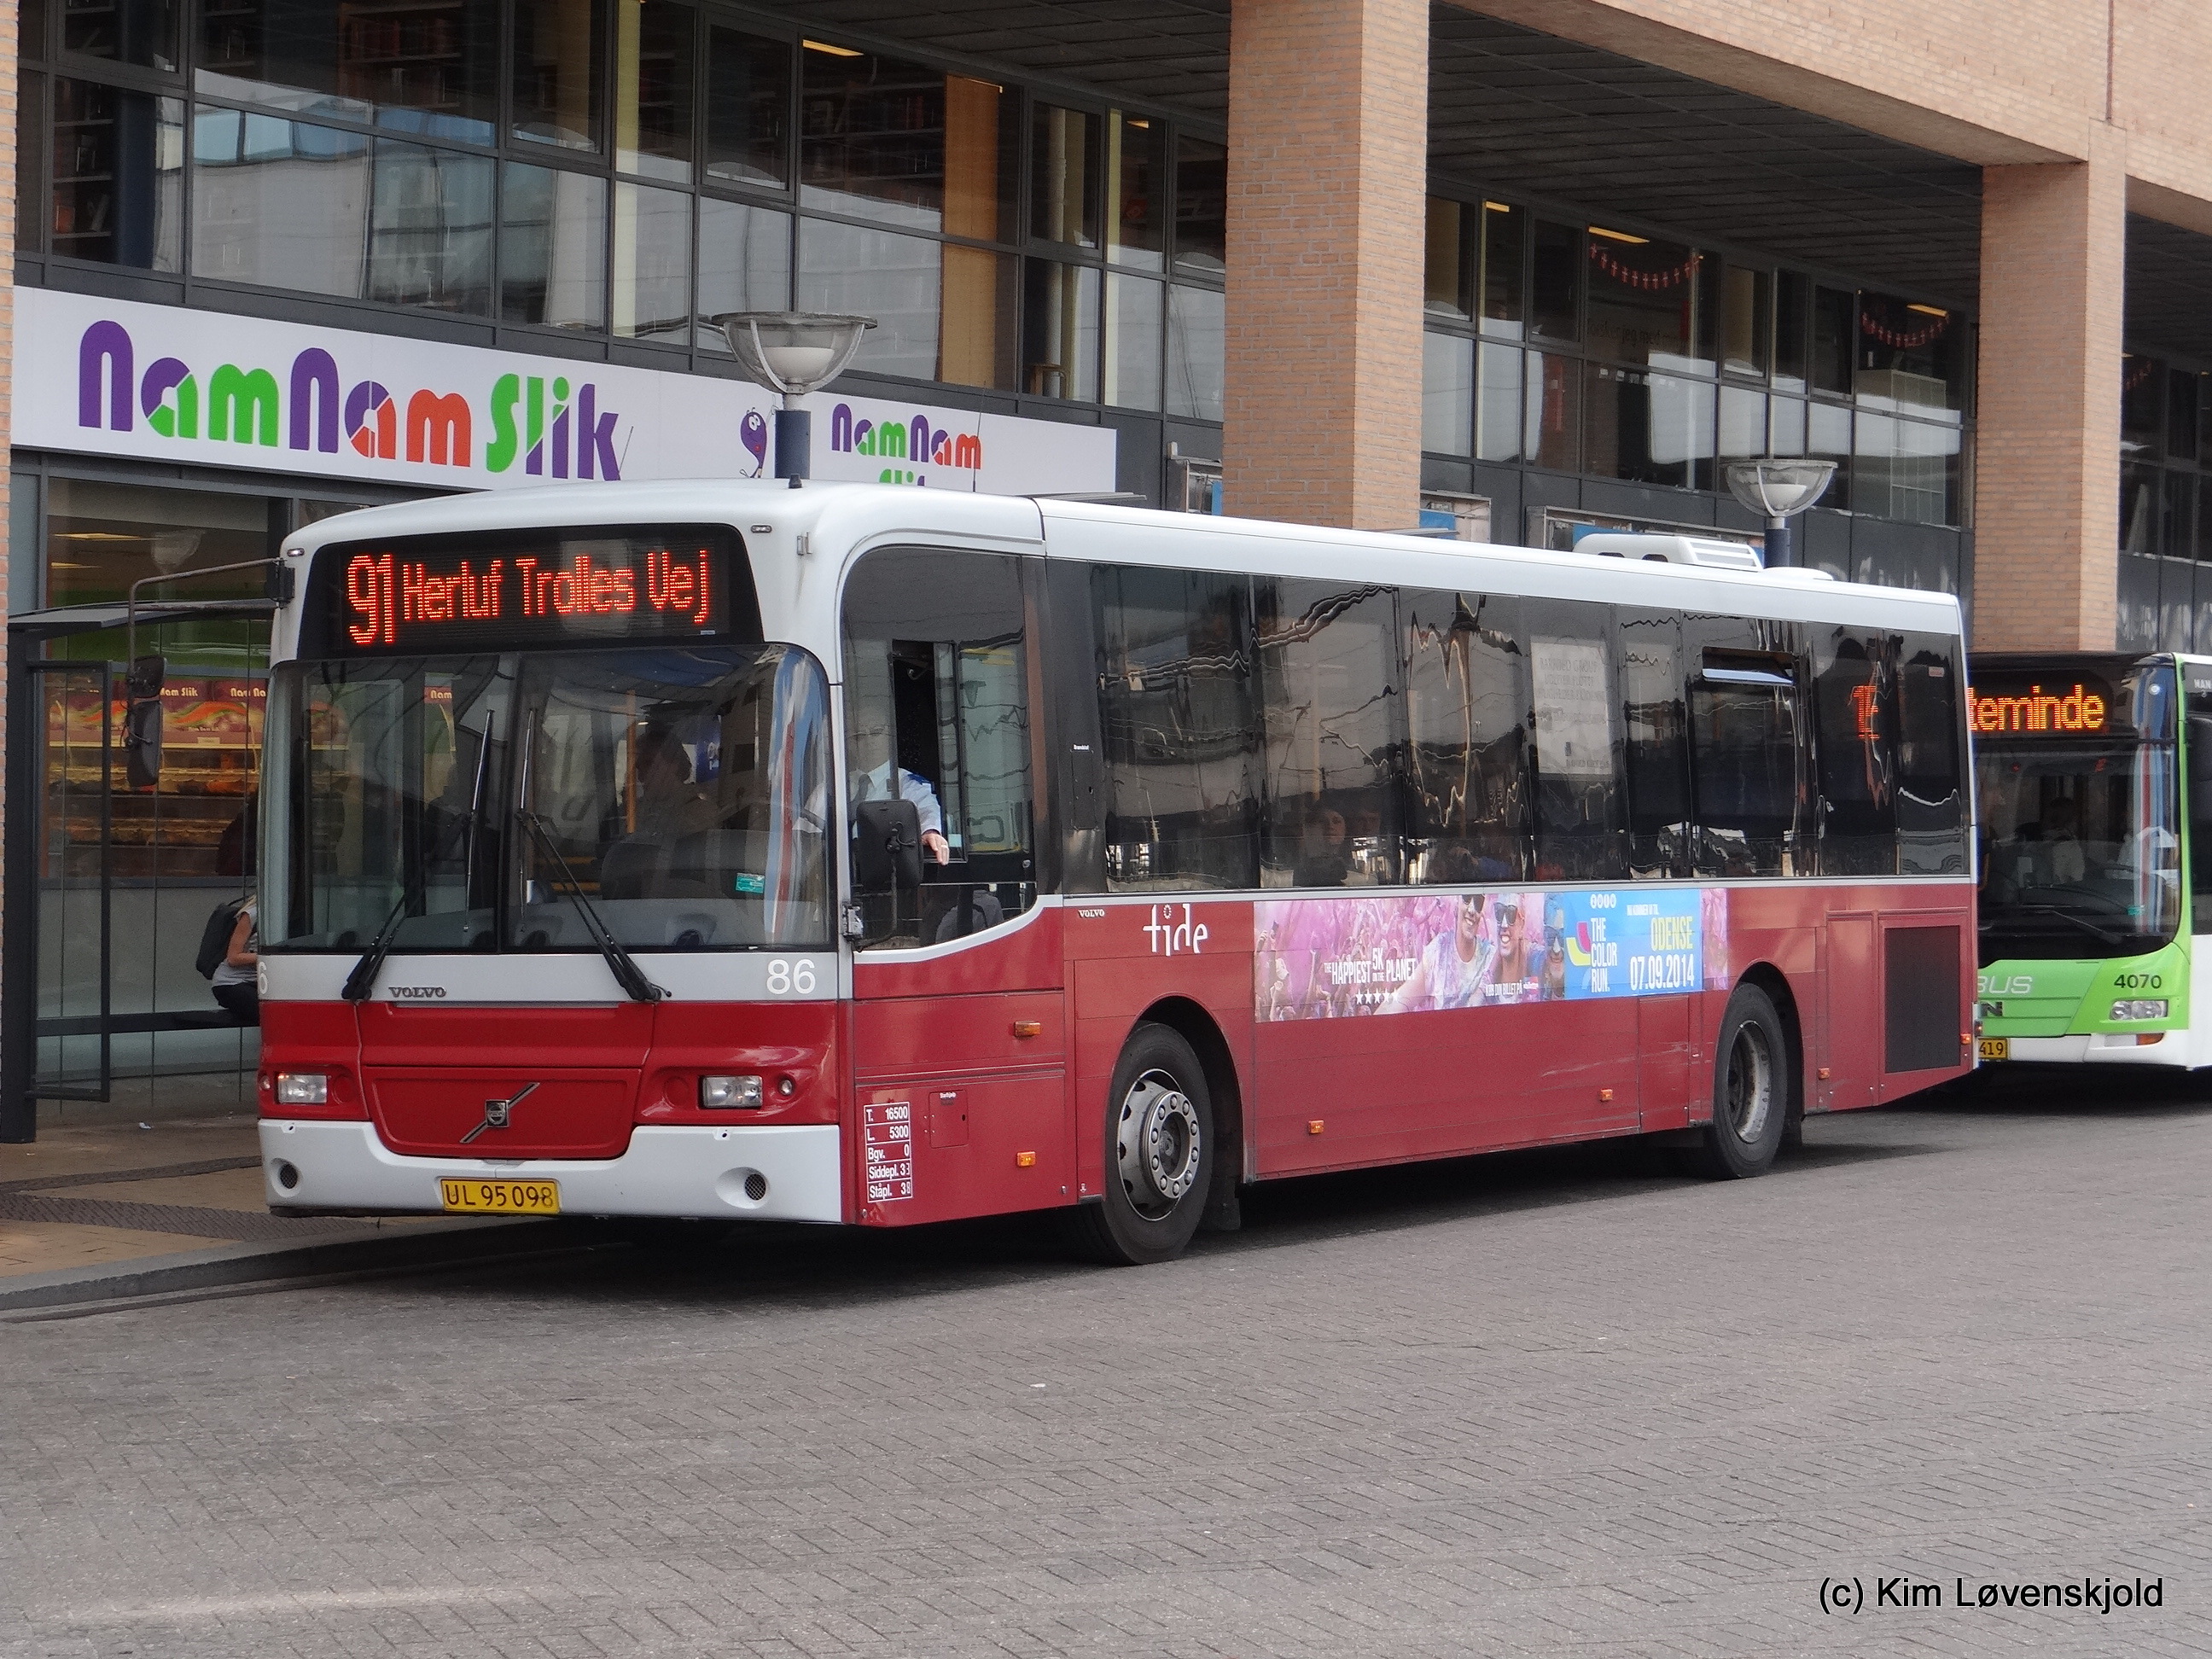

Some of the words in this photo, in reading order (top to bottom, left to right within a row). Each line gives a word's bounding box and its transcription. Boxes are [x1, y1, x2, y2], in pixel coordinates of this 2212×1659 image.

[486, 373, 621, 481] Slik
[348, 553, 393, 644] 91
[402, 559, 504, 620] Herluf
[515, 555, 634, 616] Trolles
[647, 549, 708, 625] Vej
[181, 687, 198, 696] Slik
[253, 687, 266, 697] Na
[1078, 909, 1105, 917] VOLVO
[1143, 904, 1208, 957] tide
[1591, 917, 1606, 942] THE
[1650, 916, 1693, 952] ODENSE
[1591, 942, 1617, 967] COLOR
[1331, 961, 1372, 985] HAPPIEST
[1372, 947, 1384, 970] 5K
[1386, 958, 1417, 982] PLANET
[1630, 953, 1695, 991] 07.09.2014
[766, 958, 816, 995] 86
[2114, 974, 2162, 989] 4070
[388, 987, 446, 998] VOLVO
[866, 1109, 874, 1122] T.
[885, 1106, 908, 1120] 16500
[867, 1128, 876, 1141] L.
[889, 1125, 909, 1139] 5300
[868, 1147, 885, 1162] Bgv.
[904, 1144, 910, 1156] 0
[869, 1164, 899, 1180] Siddepl.
[445, 1185, 476, 1205] UL
[869, 1183, 892, 1199] Ståpl.
